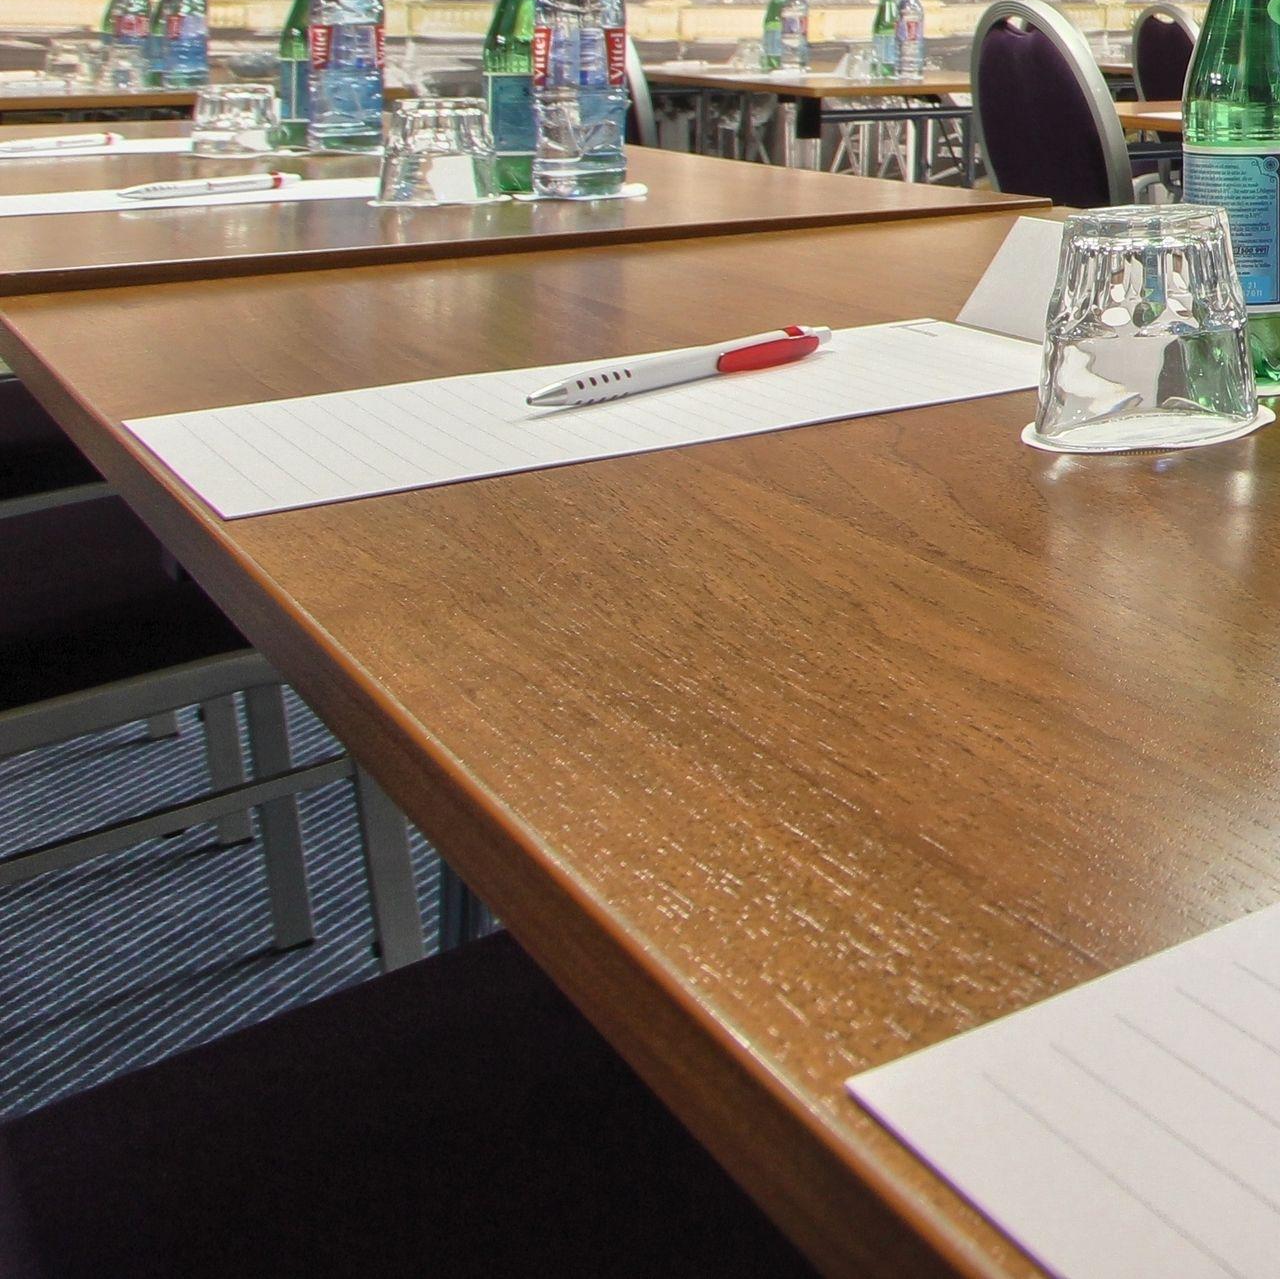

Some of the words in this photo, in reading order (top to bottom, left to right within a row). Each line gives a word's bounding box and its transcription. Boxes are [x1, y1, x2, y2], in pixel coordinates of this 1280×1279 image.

[312, 28, 328, 66] Vittel
[533, 32, 547, 83] Vittel
[611, 31, 625, 82] Vittel
